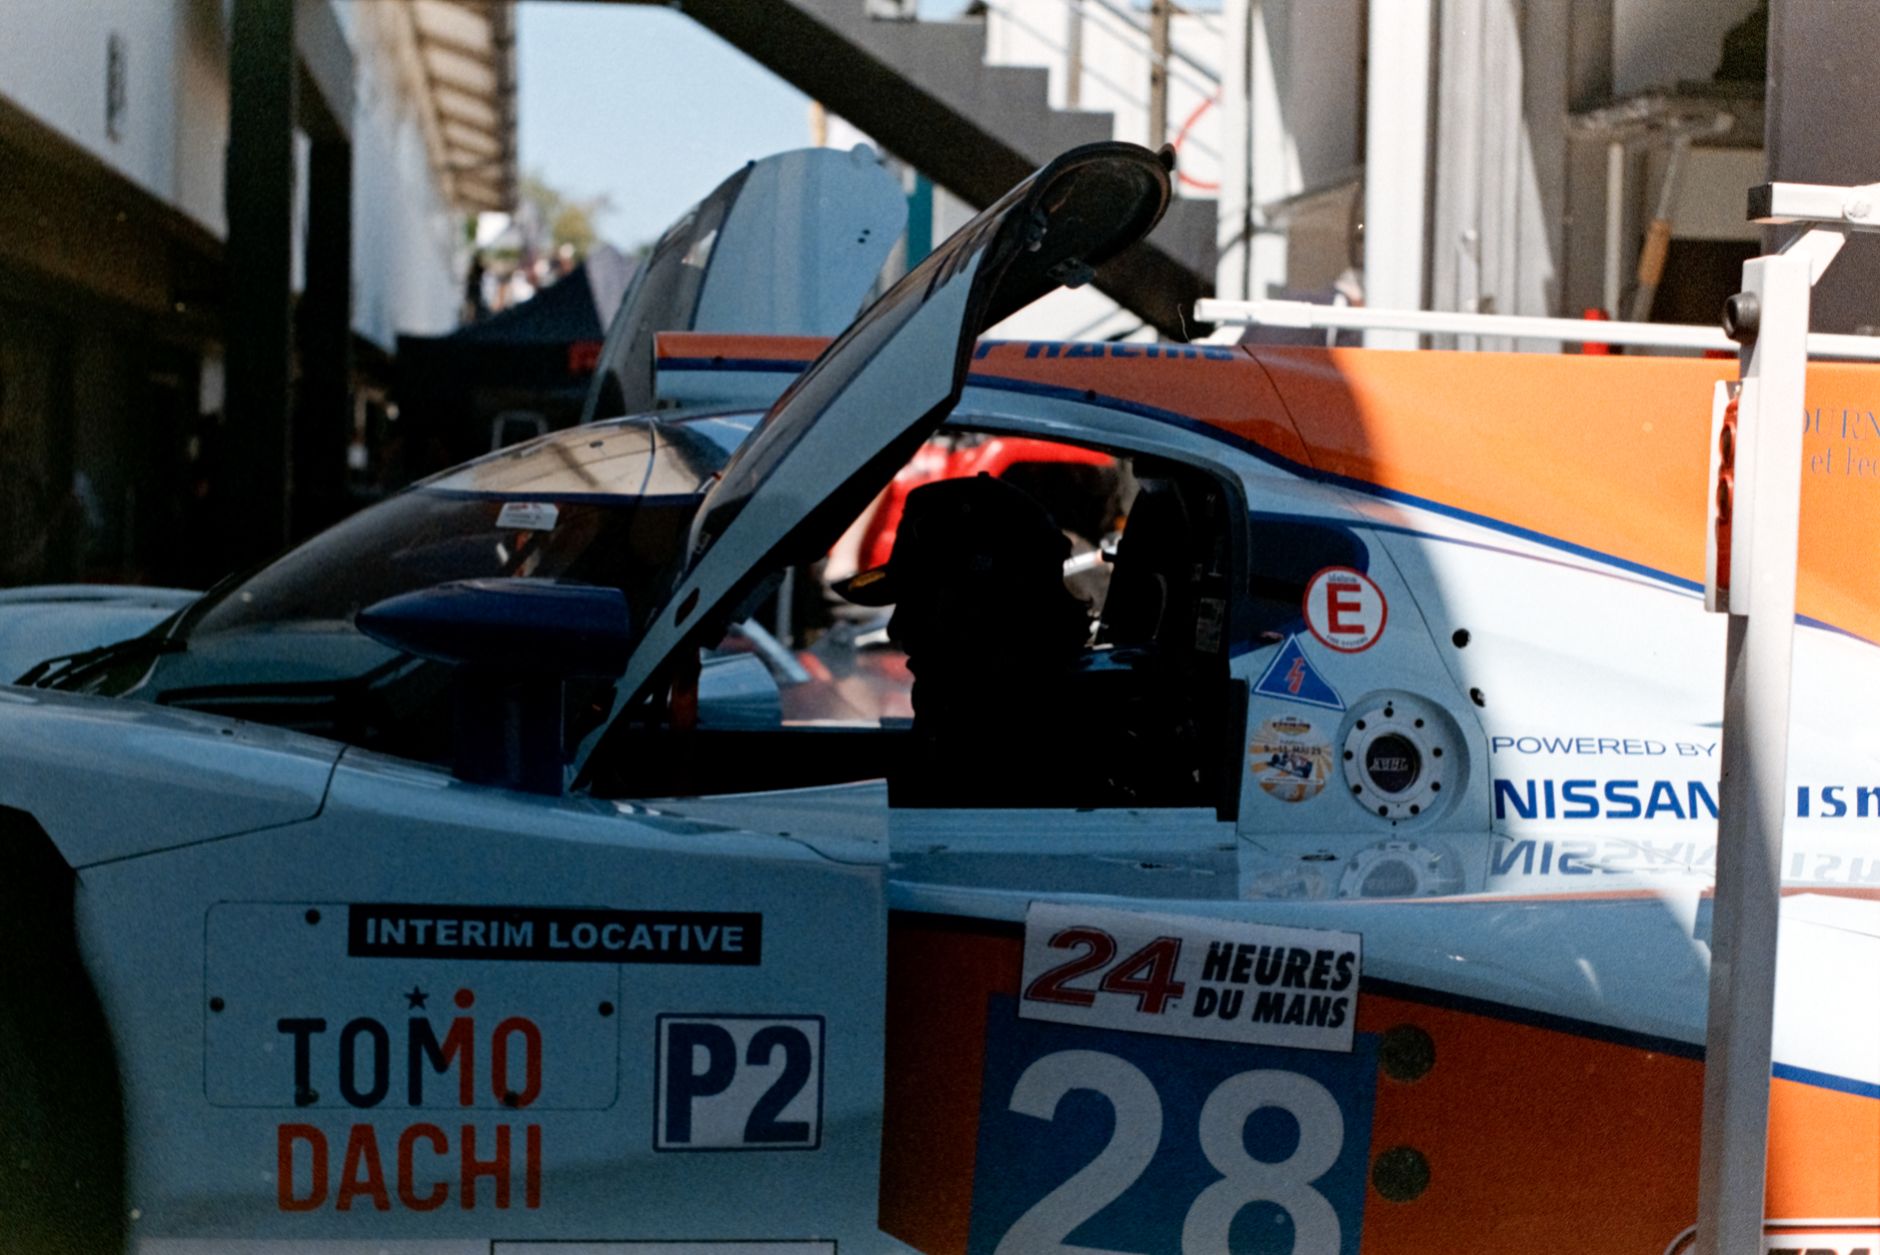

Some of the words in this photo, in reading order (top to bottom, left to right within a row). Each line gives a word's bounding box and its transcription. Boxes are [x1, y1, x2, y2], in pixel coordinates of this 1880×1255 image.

[1326, 582, 1365, 634] E
[1491, 736, 1666, 756] POWERED
[1675, 742, 1717, 757] BY
[1494, 779, 1720, 820] NISSAN
[366, 917, 534, 948] INTERIM
[549, 921, 744, 952] LOCATIVE
[1023, 925, 1186, 1014] 24
[1201, 940, 1356, 992] HEURES
[1193, 986, 1244, 1021] DU
[1252, 992, 1350, 1029] MANS
[665, 1022, 813, 1144] P2
[277, 1123, 543, 1213] DACHI
[993, 1048, 1345, 1255] 28
